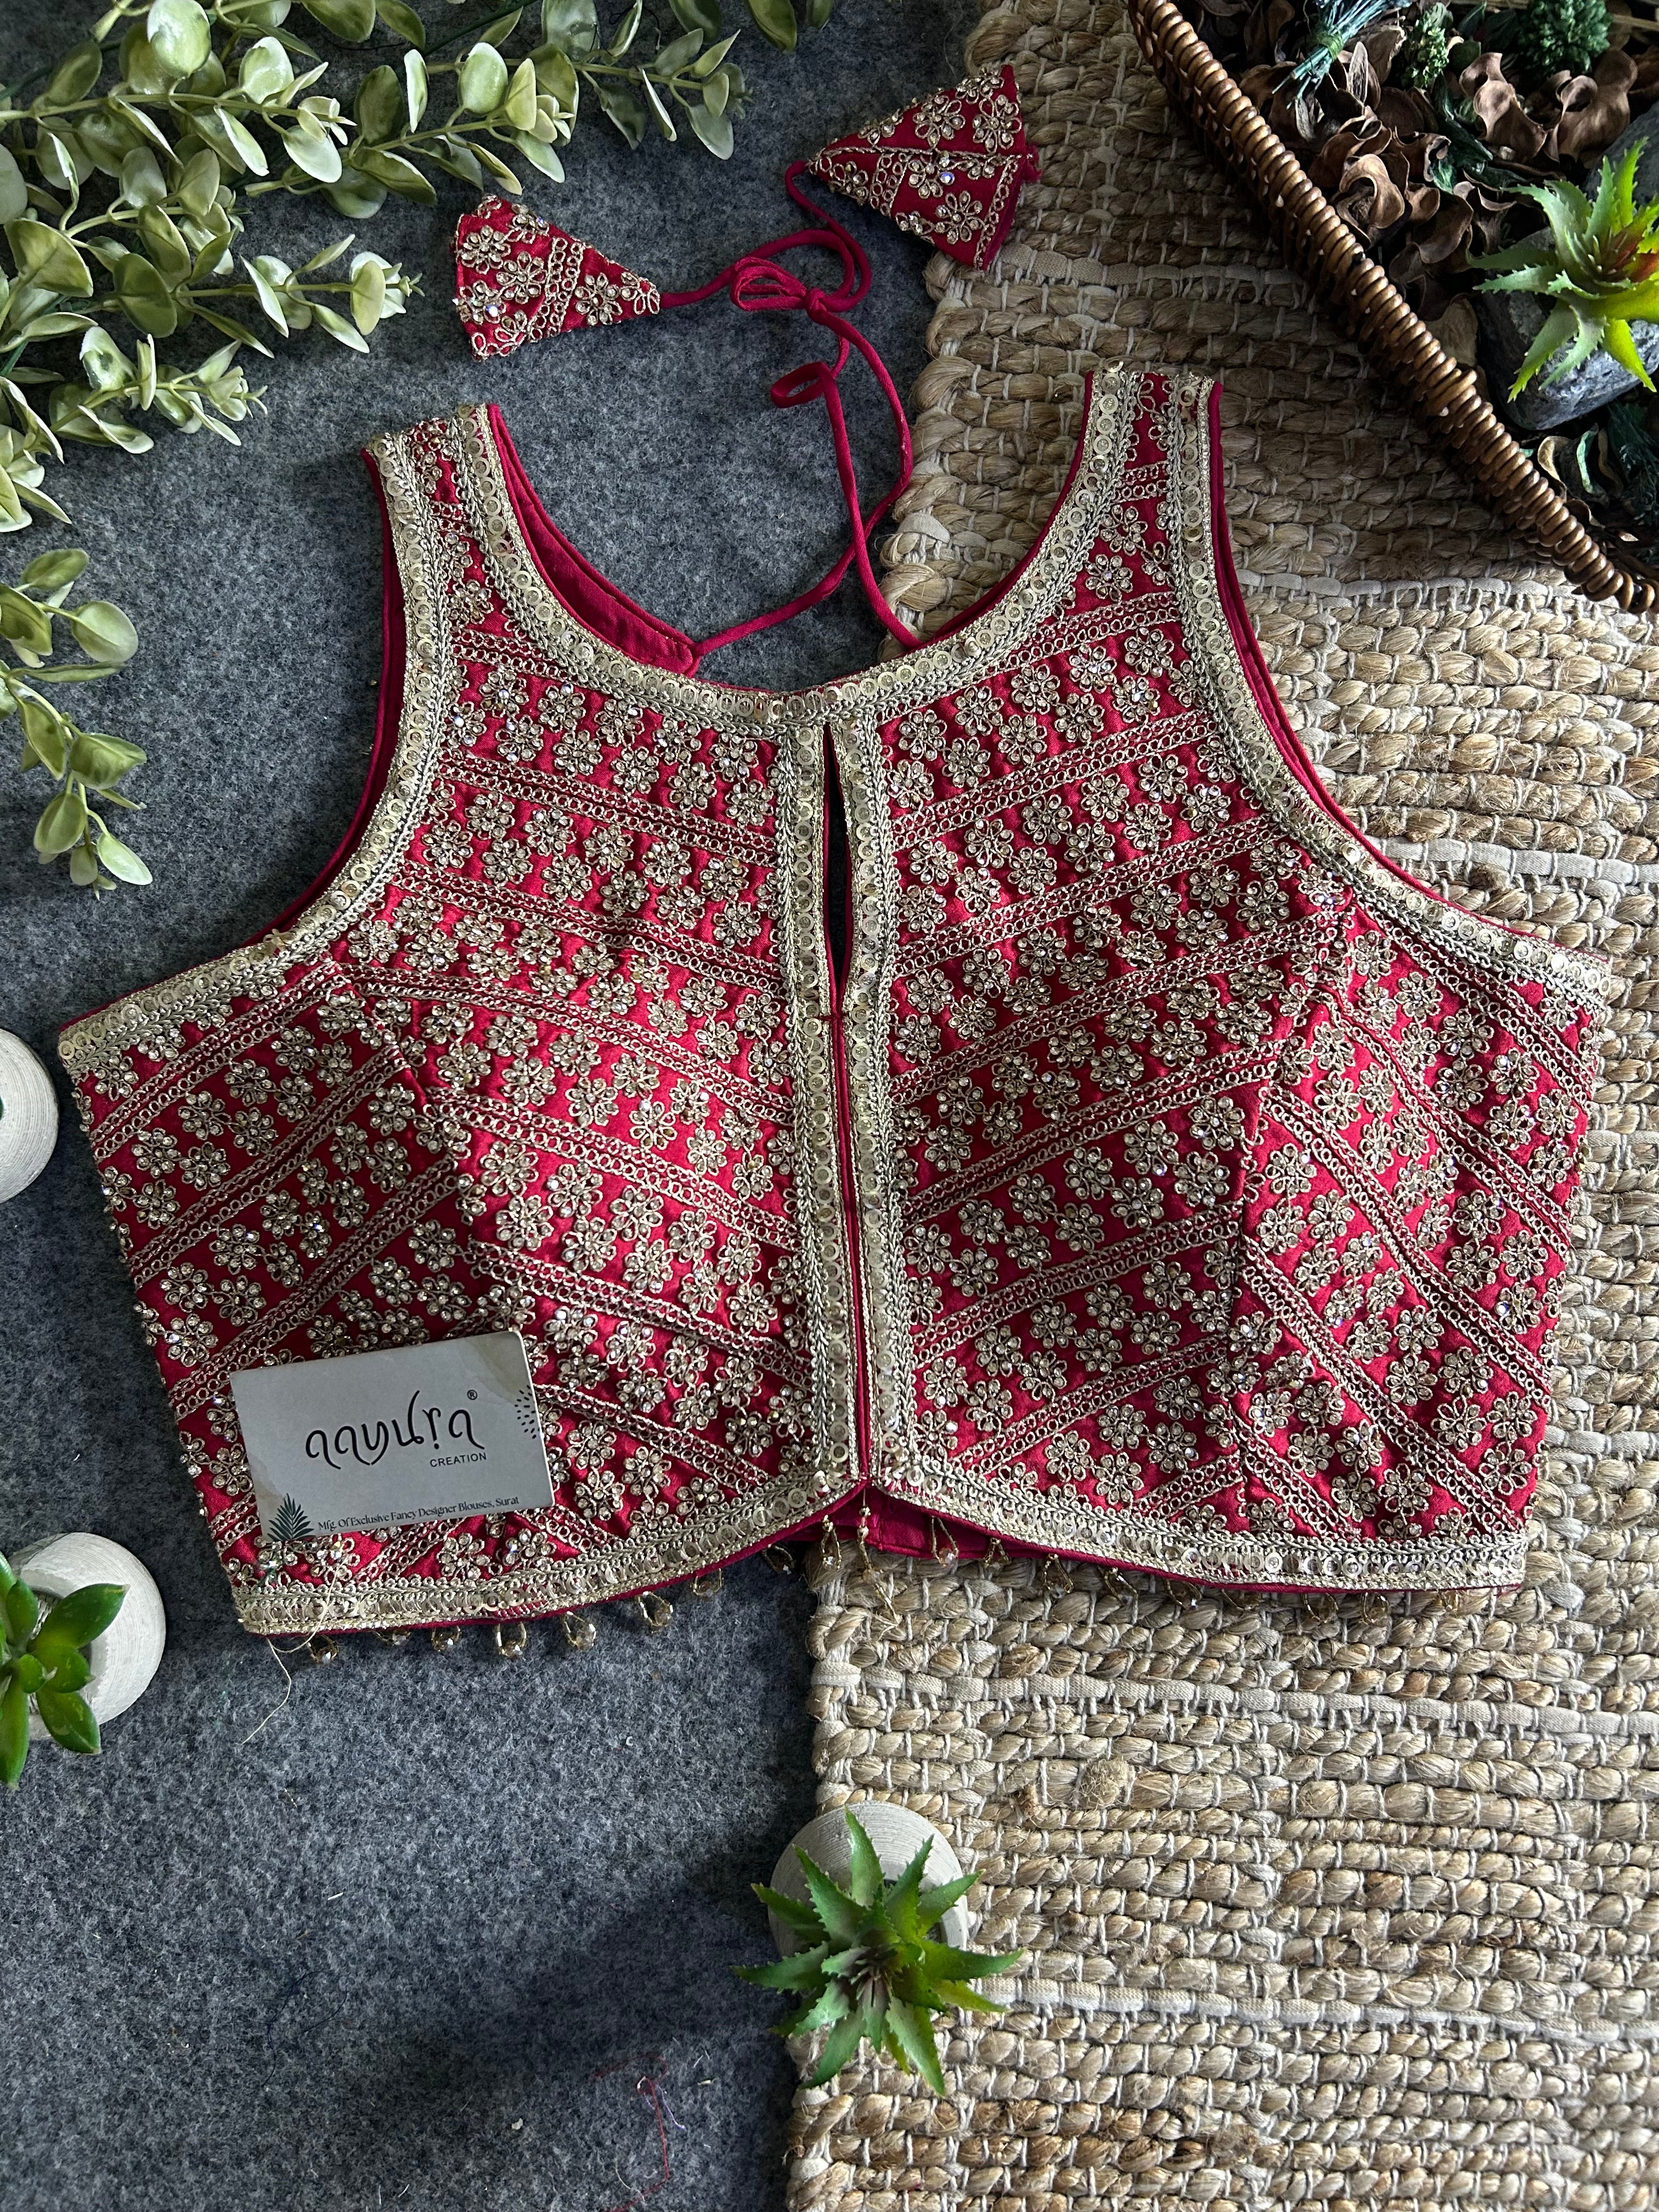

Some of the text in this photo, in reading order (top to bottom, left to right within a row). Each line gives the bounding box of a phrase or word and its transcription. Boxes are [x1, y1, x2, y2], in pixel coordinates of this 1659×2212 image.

[430, 1452, 487, 1467] CREATION
[338, 1517, 349, 1527] Of
[351, 1514, 390, 1526] Exclusive
[391, 1510, 418, 1520] Fancy
[419, 1505, 457, 1517] Designer
[458, 1501, 495, 1511] Blouses,
[495, 1496, 520, 1507] Surat
